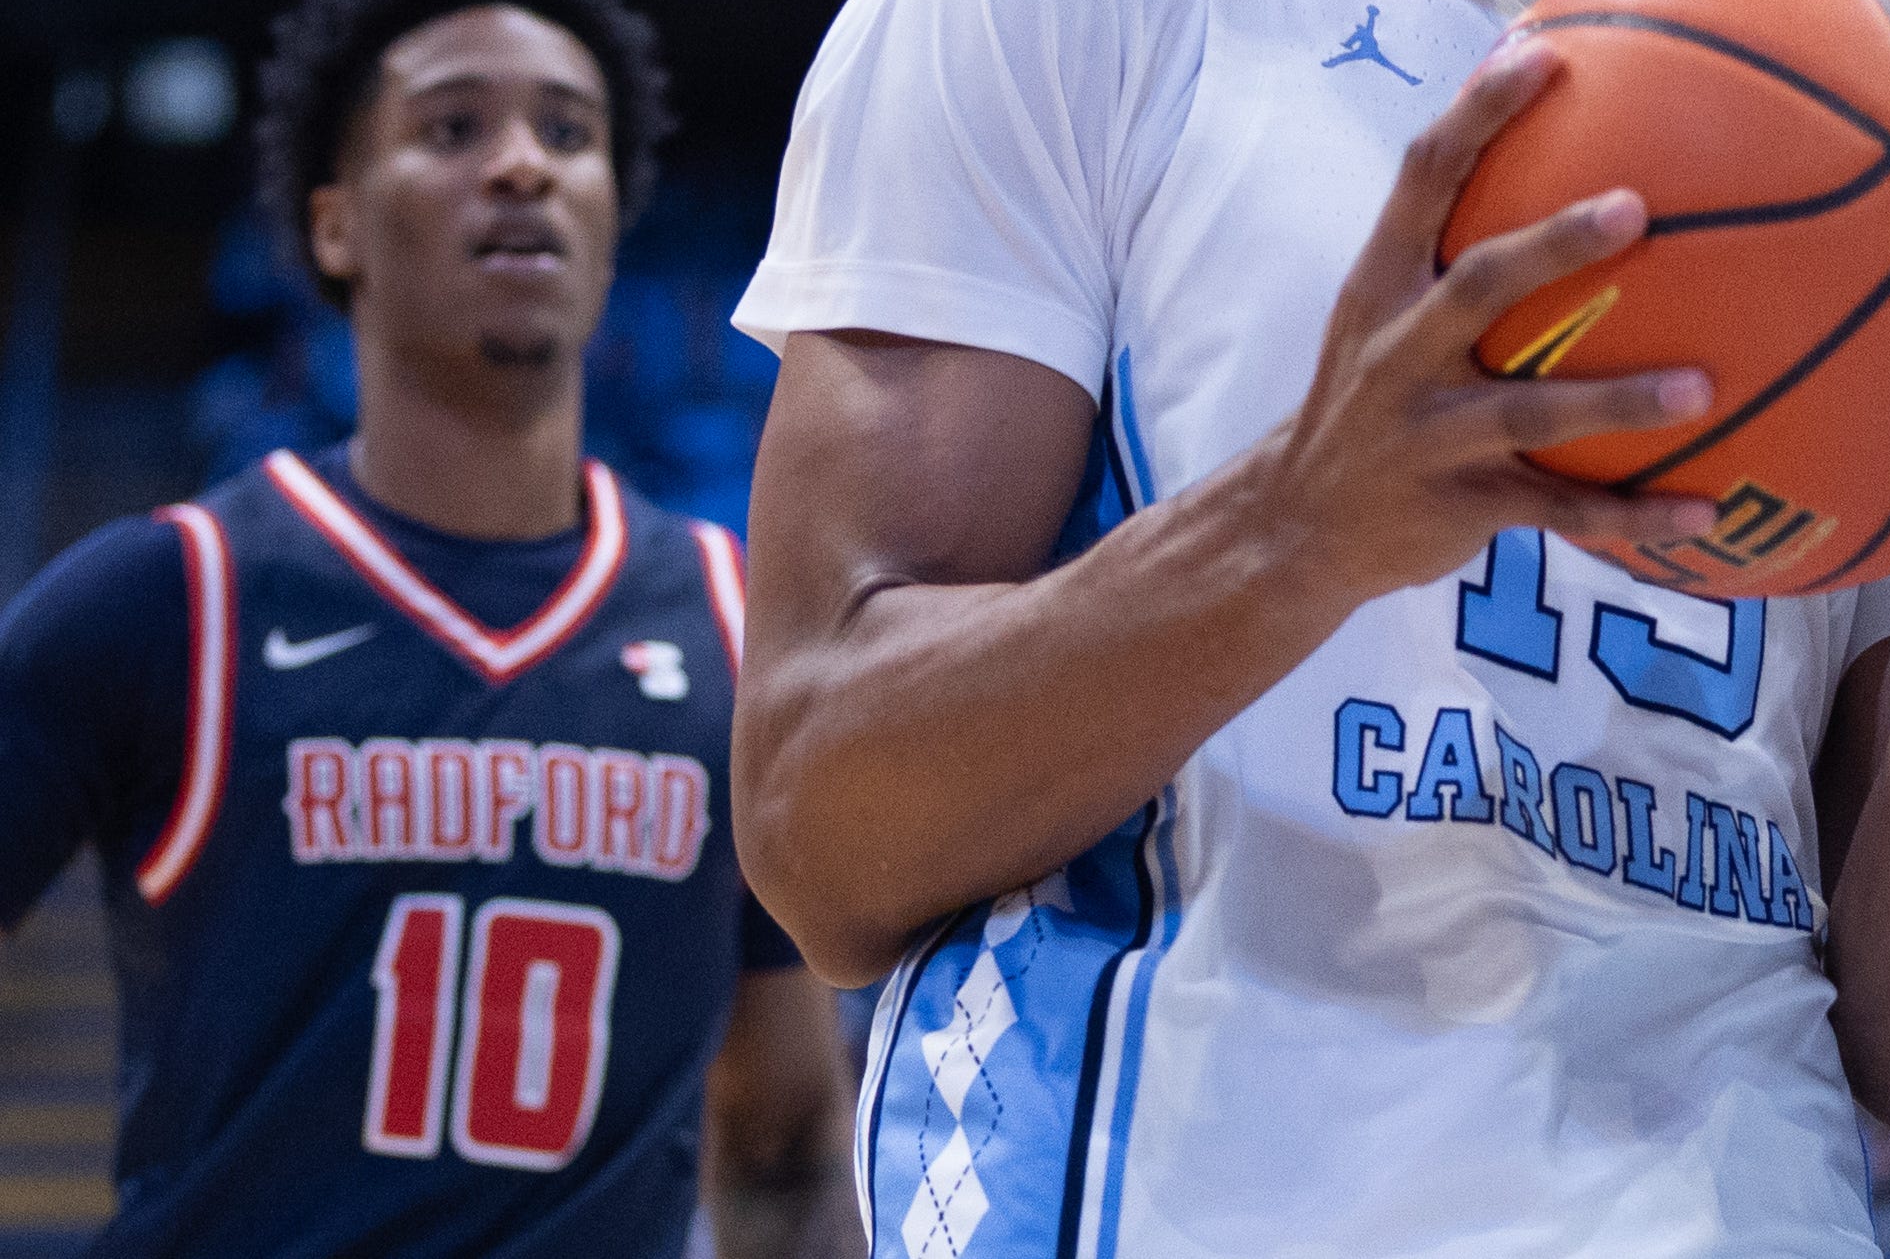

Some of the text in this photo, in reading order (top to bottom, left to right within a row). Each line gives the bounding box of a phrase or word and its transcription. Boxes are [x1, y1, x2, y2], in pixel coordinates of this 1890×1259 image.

[284, 737, 711, 882] RADFORD
[1332, 697, 1814, 932] CAROLINA
[361, 893, 622, 1171] 10
